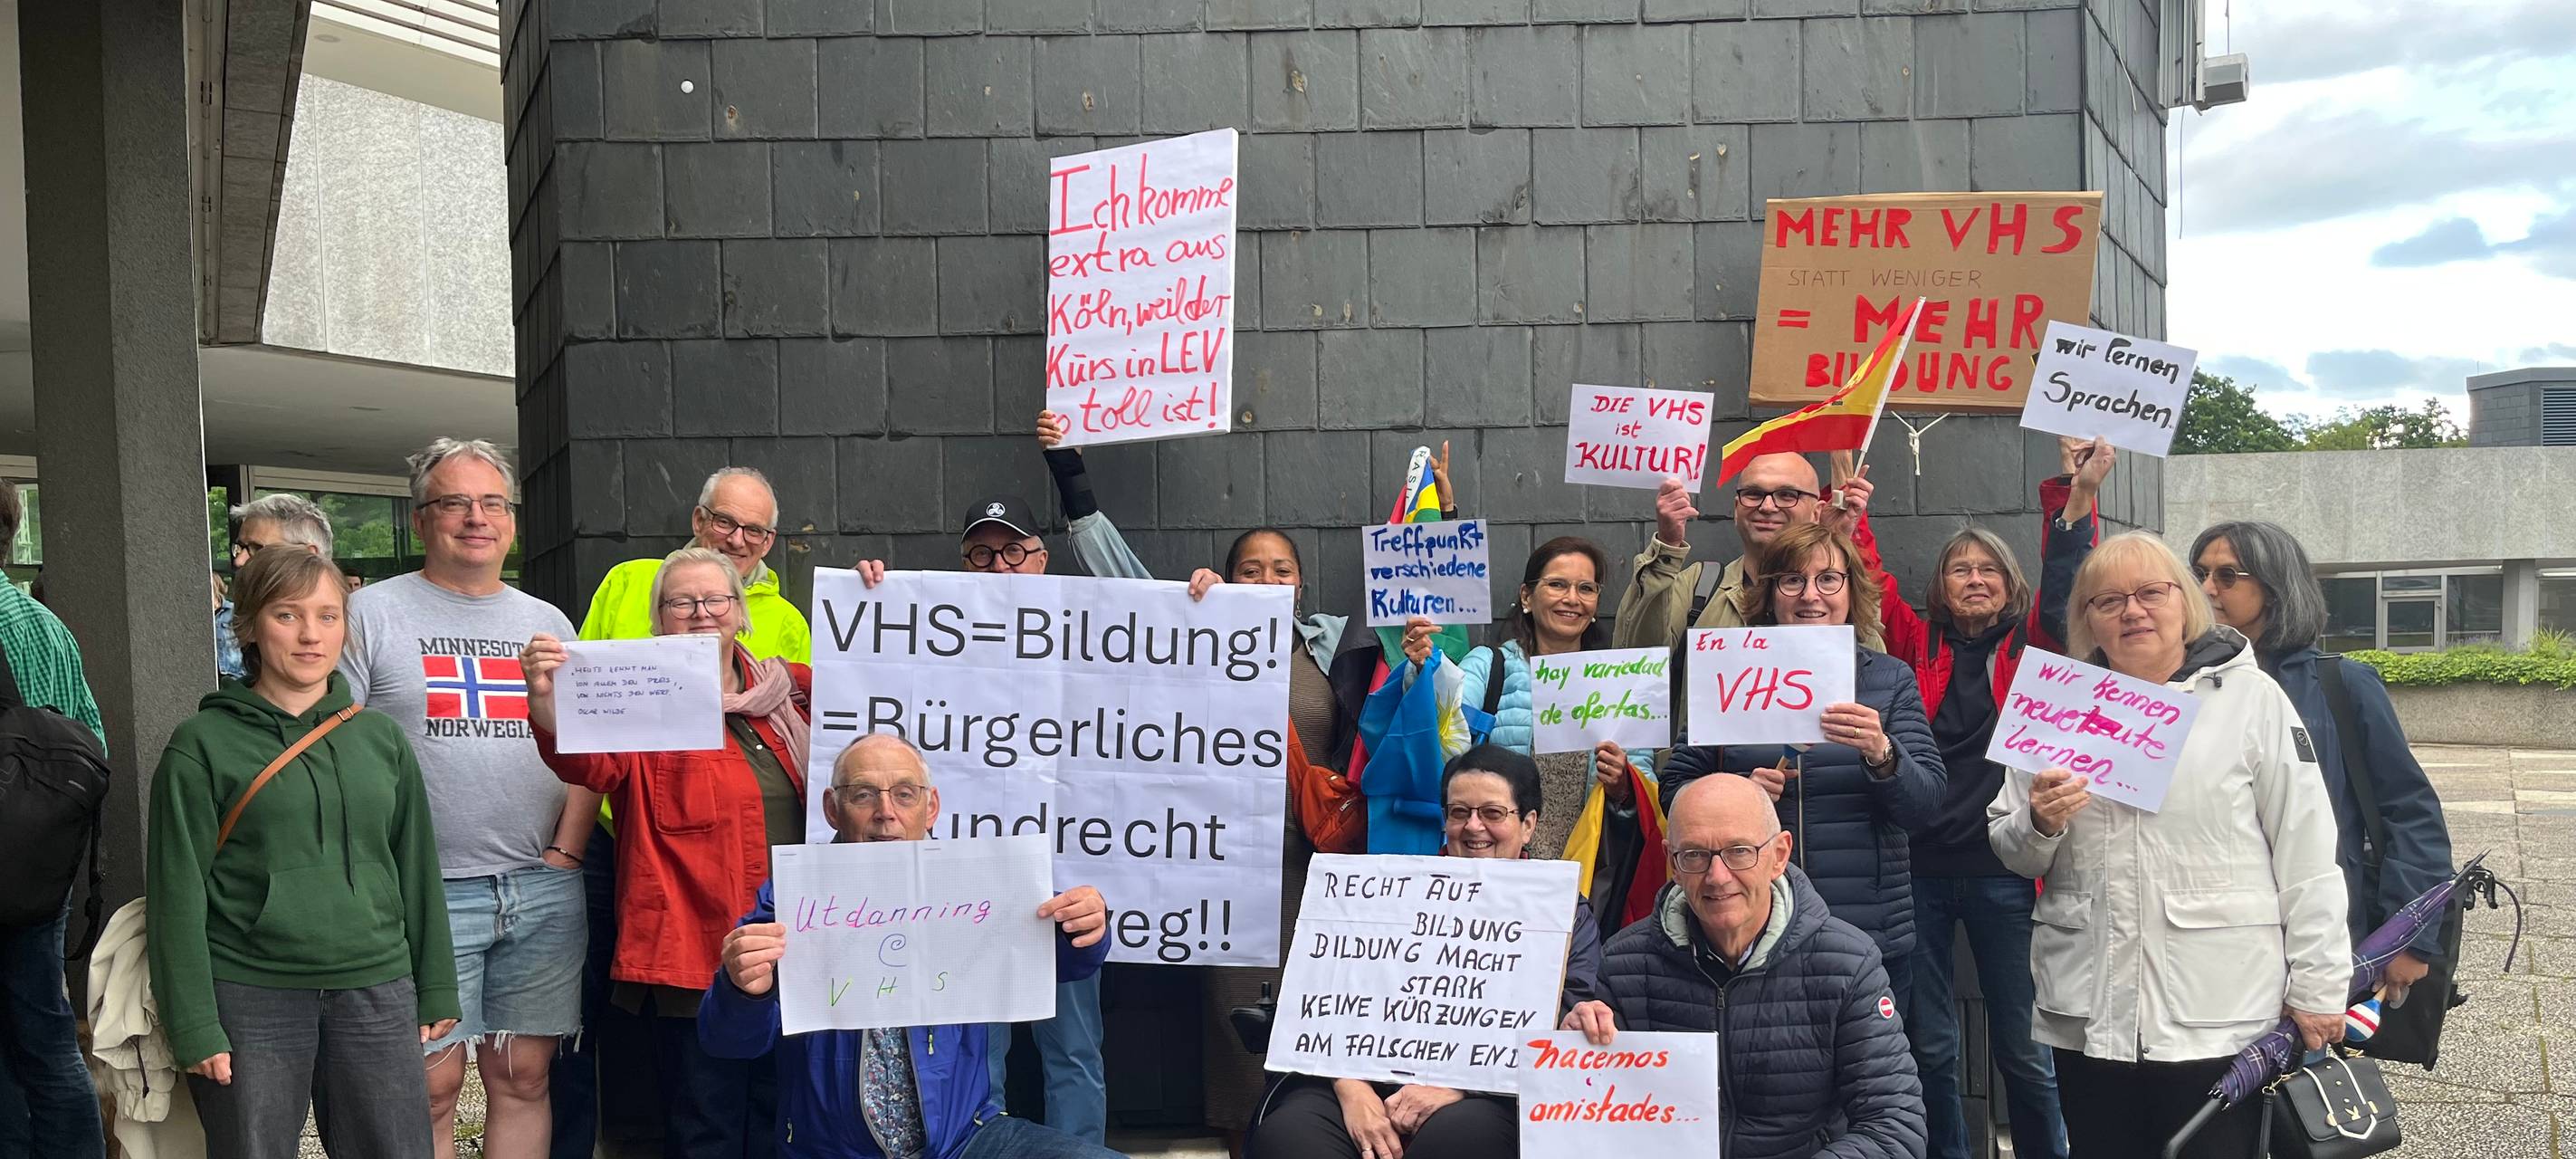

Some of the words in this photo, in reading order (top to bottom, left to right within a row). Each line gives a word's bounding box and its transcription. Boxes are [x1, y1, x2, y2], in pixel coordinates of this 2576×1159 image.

[1050, 164, 1130, 235] Ich
[1139, 153, 1233, 225] komme
[1776, 208, 1912, 248] MEHR
[1941, 203, 2083, 254] VHS
[1050, 231, 1155, 277] extra
[1166, 235, 1226, 263] aus
[1789, 269, 1850, 288] STATT
[1871, 269, 1982, 289] WENIGER
[1854, 294, 2044, 350] MEHR
[1126, 349, 1155, 378] in
[1161, 328, 1225, 374] LEV
[2056, 339, 2096, 359] wir
[1080, 386, 1152, 433] toll
[1163, 382, 1217, 428] ist!
[1590, 395, 1634, 414] DIE
[1648, 397, 1705, 426] VHS
[1615, 422, 1642, 437] ist
[1574, 442, 1706, 481] KULTUR!
[1370, 554, 1486, 580] verschiedene
[419, 637, 524, 657] MINNESOT
[822, 598, 1278, 682] VHS=Bildung!
[1696, 631, 1726, 651] En
[1742, 630, 1770, 650] la
[1535, 658, 1571, 690] hay
[1583, 656, 1668, 680] variedad
[2037, 661, 2085, 686] wir
[1716, 666, 1813, 714] VHS
[425, 719, 534, 739] NORWEGIA
[1540, 702, 1562, 726] de
[823, 695, 1283, 768] =Bürgerliches
[1325, 872, 1411, 900] RECHT
[797, 895, 991, 933] Utdanning
[1106, 898, 1232, 963] eg!!
[1411, 912, 1522, 943] BILDUNG
[1310, 933, 1420, 963] BILDUNG
[1436, 943, 1522, 972] MACHT
[1399, 975, 1487, 1000] STARK
[1301, 992, 1372, 1020] KEINE
[1383, 997, 1537, 1030] KÜRZUNGEN
[1295, 1032, 1332, 1057] AM
[1346, 1034, 1460, 1062] FALSCHEN
[1526, 1039, 1669, 1072] hacemos
